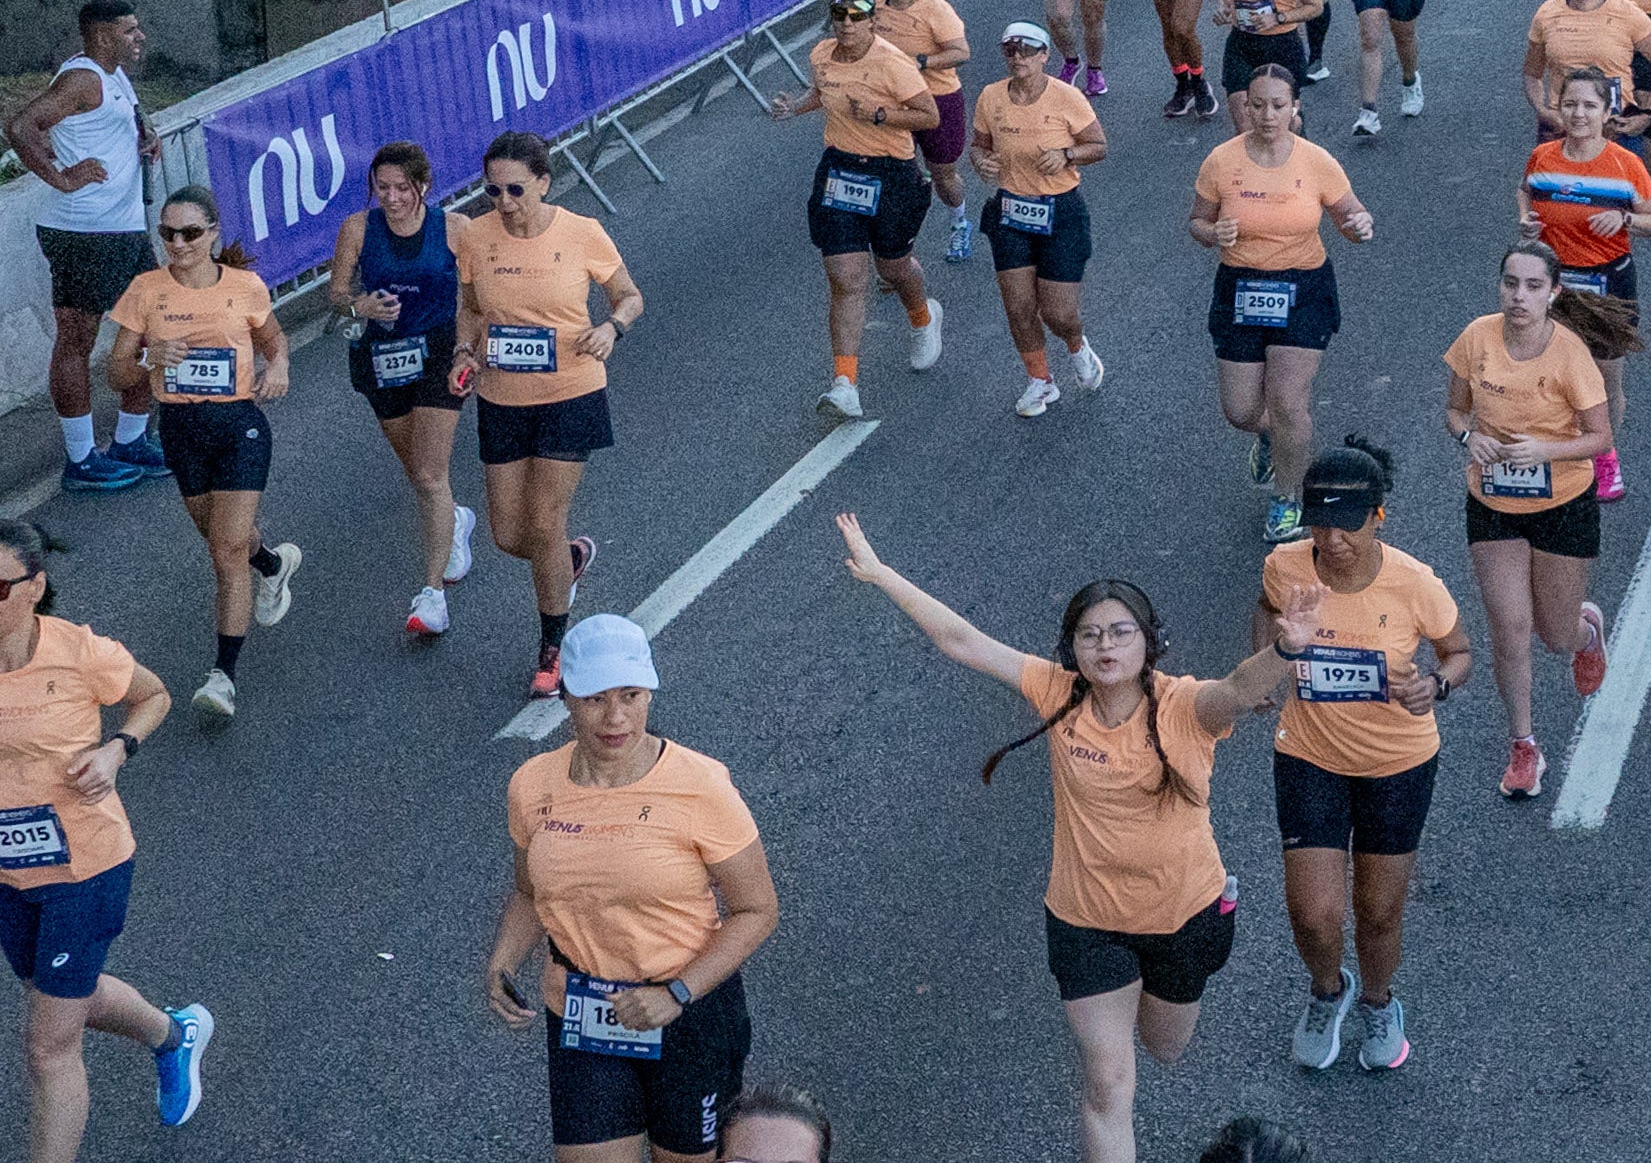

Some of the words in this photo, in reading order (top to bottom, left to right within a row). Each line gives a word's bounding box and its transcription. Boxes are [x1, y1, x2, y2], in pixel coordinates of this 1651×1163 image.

[486, 12, 557, 122] nu
[247, 114, 346, 242] nu
[842, 184, 869, 199] 1991
[1013, 202, 1046, 219] 2059
[1248, 295, 1286, 309] 2509
[504, 342, 545, 357] 2408
[384, 354, 419, 370] 2374
[189, 363, 220, 378] 785
[1300, 663, 1307, 679] E
[1322, 667, 1371, 683] 1975
[568, 999, 579, 1017] D
